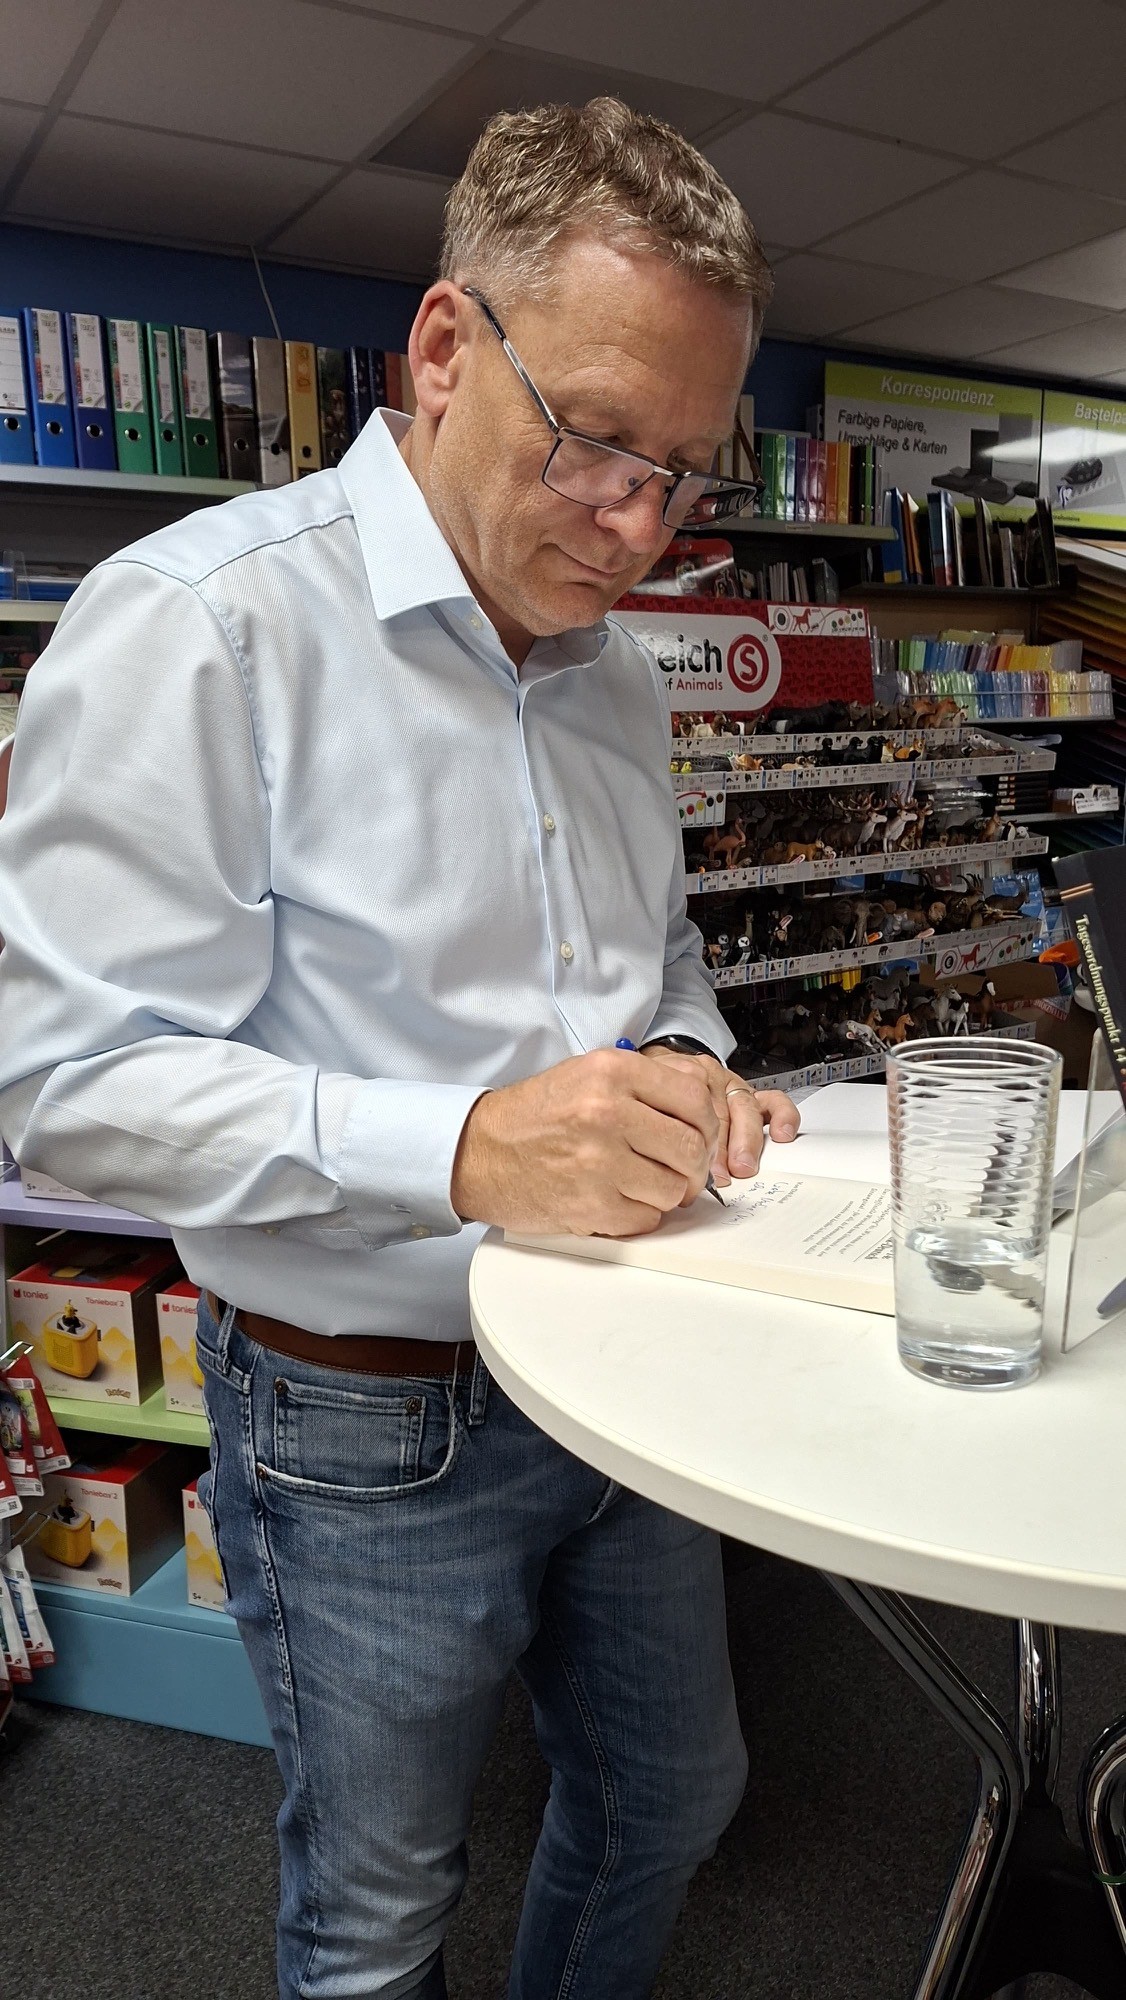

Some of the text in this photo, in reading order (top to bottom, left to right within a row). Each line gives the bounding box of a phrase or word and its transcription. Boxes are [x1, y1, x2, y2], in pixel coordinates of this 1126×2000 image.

[881, 376, 995, 408] Korrespondenz
[837, 408, 927, 435] Farbige Papiere,
[901, 436, 910, 451] &
[912, 439, 948, 455] Karten
[657, 634, 723, 673] eich
[664, 677, 724, 691] f Animals
[1075, 914, 1122, 1044] Tagesordnungspunkt
[23, 1290, 48, 1300] tonies
[85, 1296, 118, 1307] Toniebox
[172, 1304, 198, 1315] tonies
[80, 1488, 112, 1499] Toniebox
